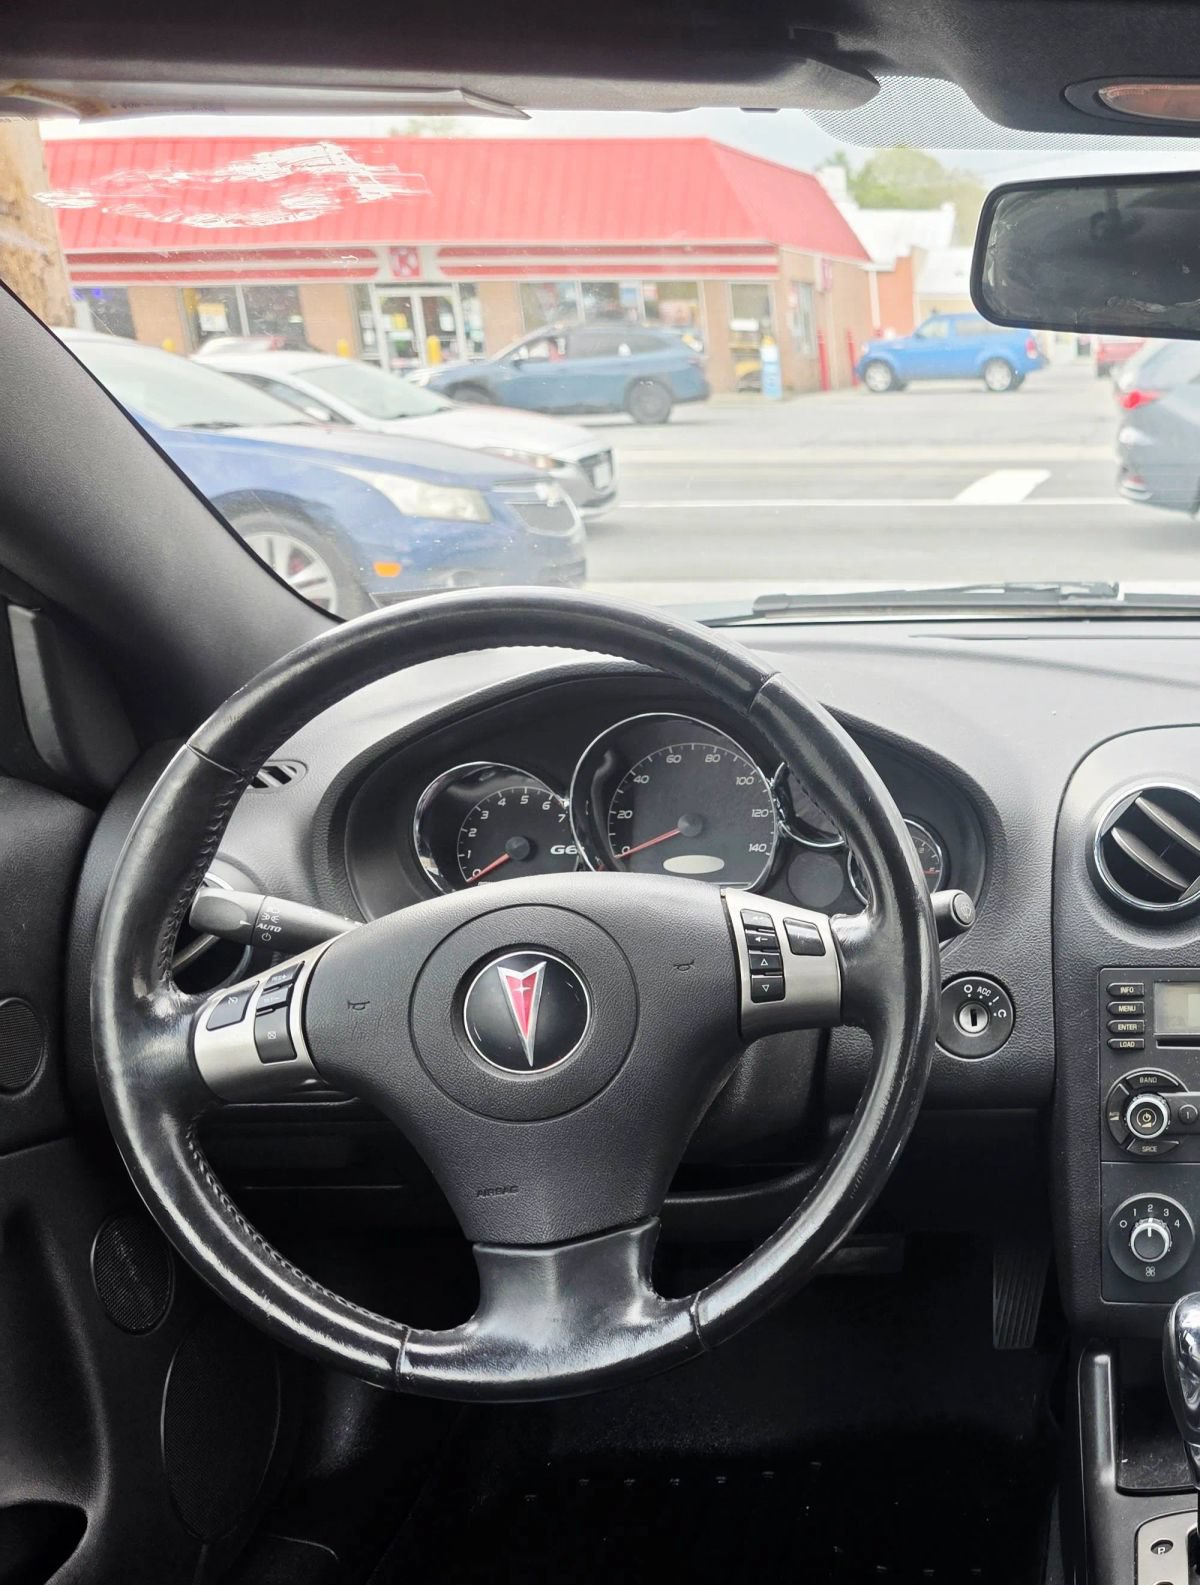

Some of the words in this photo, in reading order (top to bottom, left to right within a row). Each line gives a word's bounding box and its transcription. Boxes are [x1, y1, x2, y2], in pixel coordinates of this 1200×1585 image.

[393, 252, 418, 277] K
[666, 755, 682, 764] 60
[705, 754, 721, 763] 80
[633, 775, 650, 784] 40
[735, 776, 754, 785] 100
[497, 798, 506, 806] 4
[520, 795, 530, 805] 5
[542, 801, 551, 810] 6
[480, 811, 489, 820] 3
[617, 810, 633, 819] 20
[751, 809, 769, 817] 120
[558, 814, 566, 823] 7
[468, 828, 477, 837] 2
[550, 845, 578, 855] G6
[748, 844, 767, 852] 140
[467, 850, 472, 859] 1
[257, 923, 282, 933] AUTO
[976, 986, 992, 997] ACC
[1118, 1023, 1137, 1031] ENTER
[476, 1185, 519, 1198] AIRBAG
[1133, 1208, 1137, 1217] 1
[1147, 1204, 1153, 1212] 2
[1163, 1208, 1169, 1217] 3
[1174, 1219, 1180, 1228] 4
